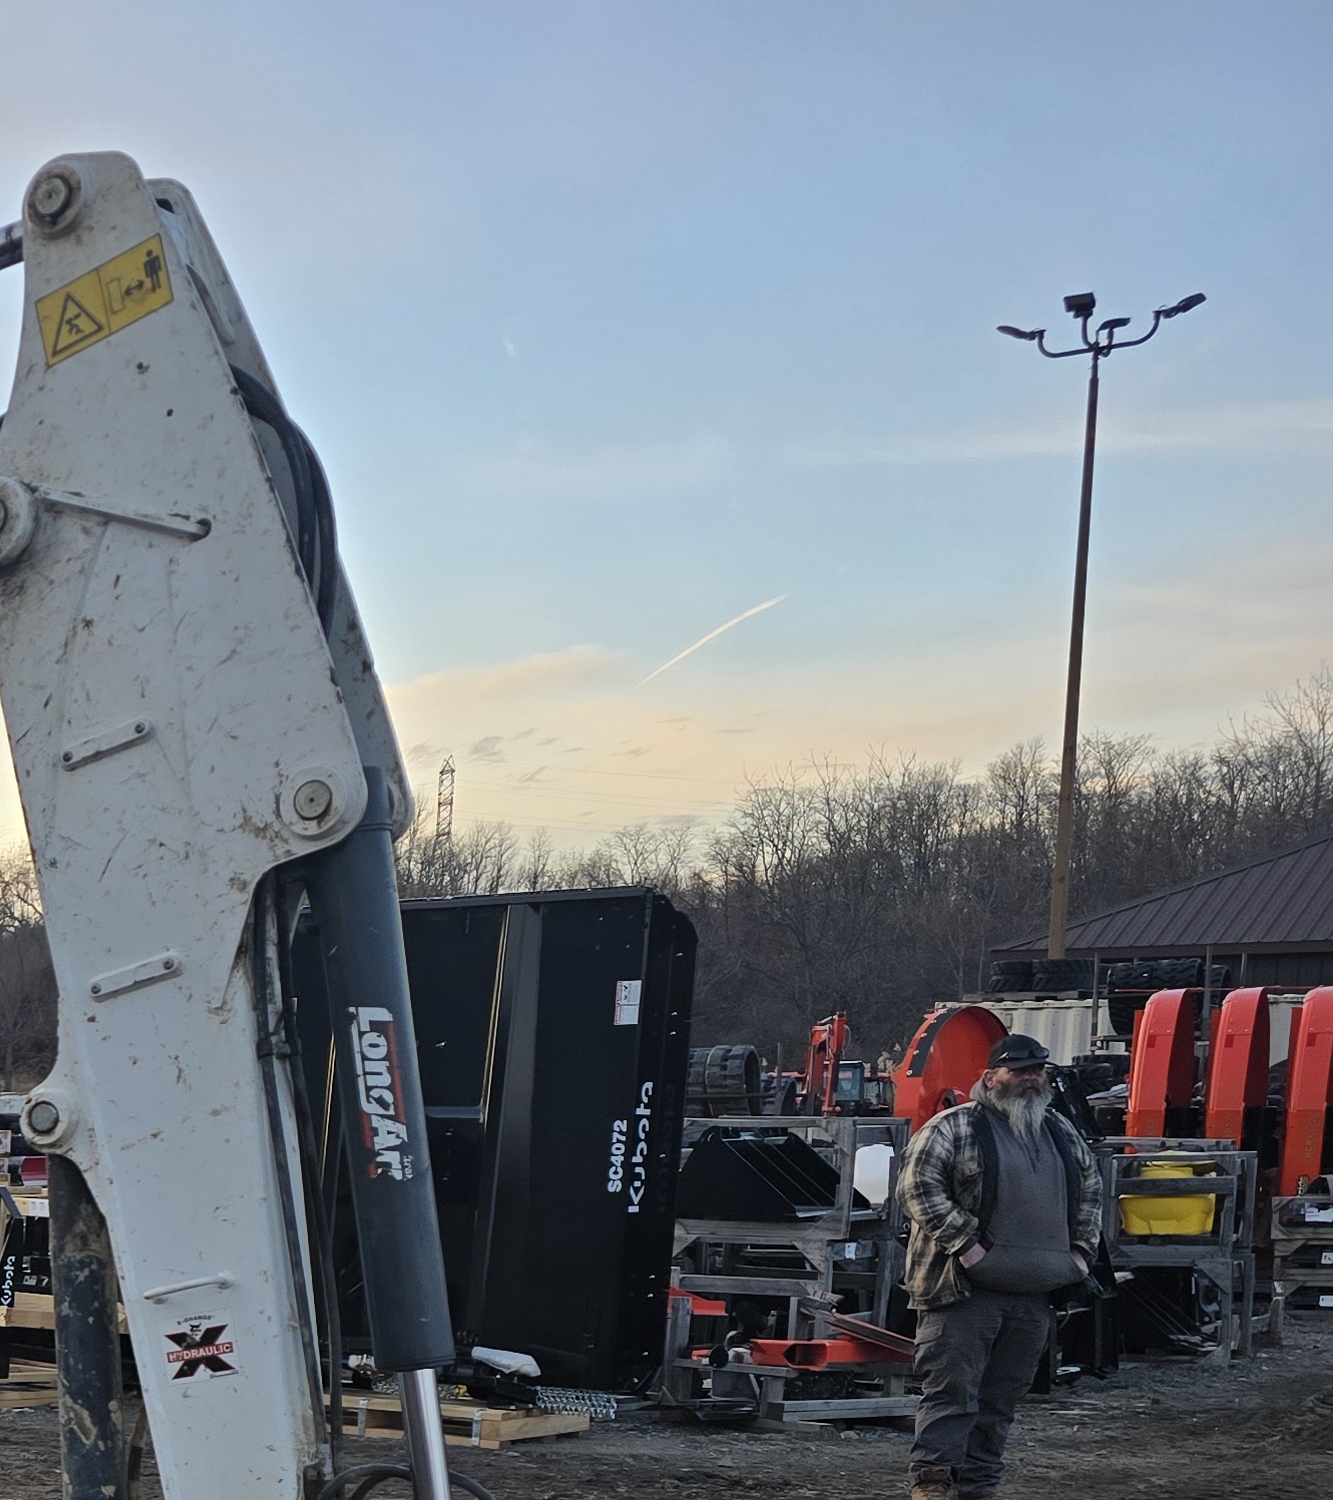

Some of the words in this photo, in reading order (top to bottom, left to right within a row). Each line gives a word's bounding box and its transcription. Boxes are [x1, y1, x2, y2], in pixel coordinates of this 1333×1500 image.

[607, 1119, 628, 1193] SC4072
[627, 1081, 653, 1213] Kubota
[168, 1343, 232, 1362] HYDRAULIC
